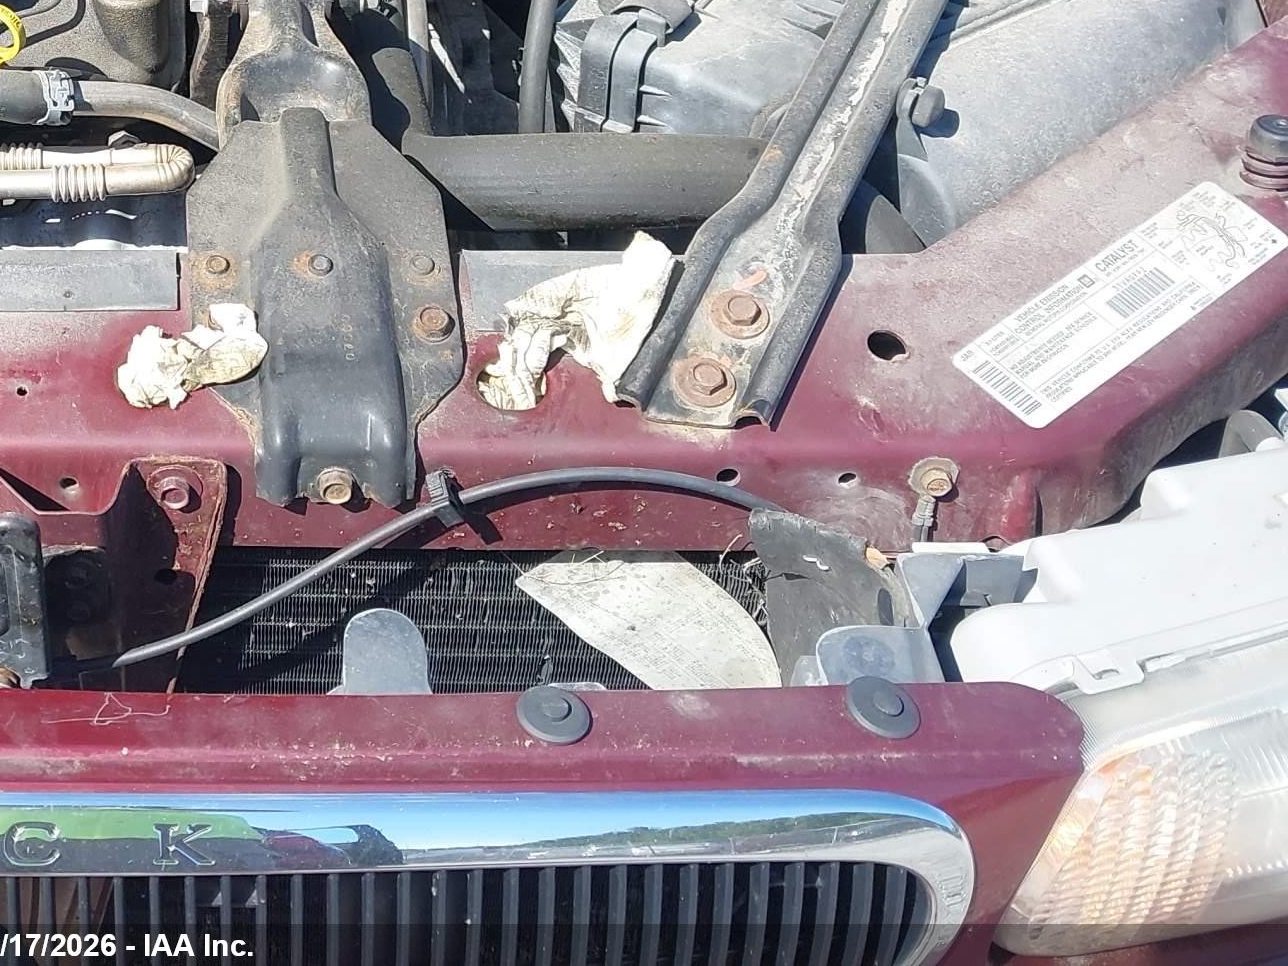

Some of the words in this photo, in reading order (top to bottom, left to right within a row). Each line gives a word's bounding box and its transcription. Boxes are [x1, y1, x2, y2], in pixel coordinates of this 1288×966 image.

[1093, 239, 1139, 272] CATALYST
[1013, 302, 1041, 322] VEHICLE
[1038, 283, 1069, 305] EMISSION
[1013, 312, 1044, 334] CONTROL
[1043, 284, 1084, 313] INFORMATION
